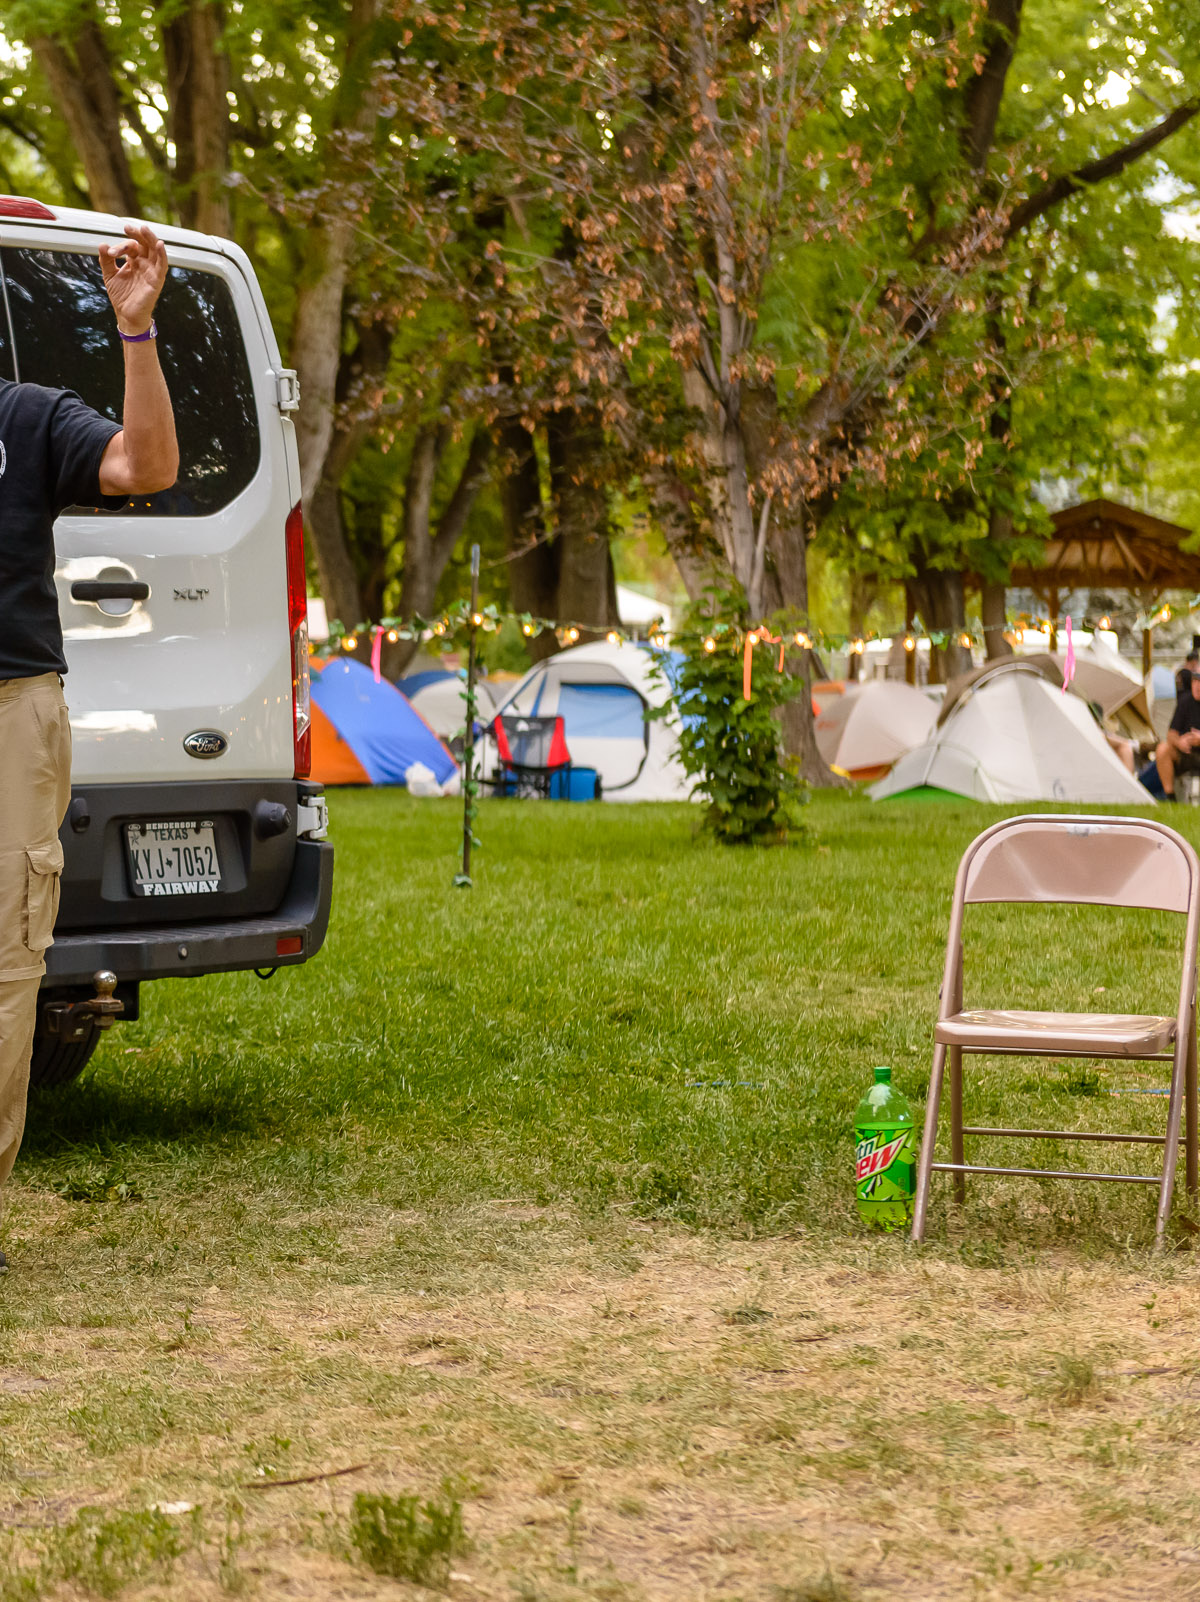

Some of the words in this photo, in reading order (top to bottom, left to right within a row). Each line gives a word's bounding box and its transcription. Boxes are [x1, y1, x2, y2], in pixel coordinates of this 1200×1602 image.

[173, 588, 210, 601] XLT
[189, 737, 221, 752] Ford
[145, 821, 197, 830] HENDERSON
[153, 829, 189, 841] TEXAS
[143, 880, 219, 896] FAIRWAY
